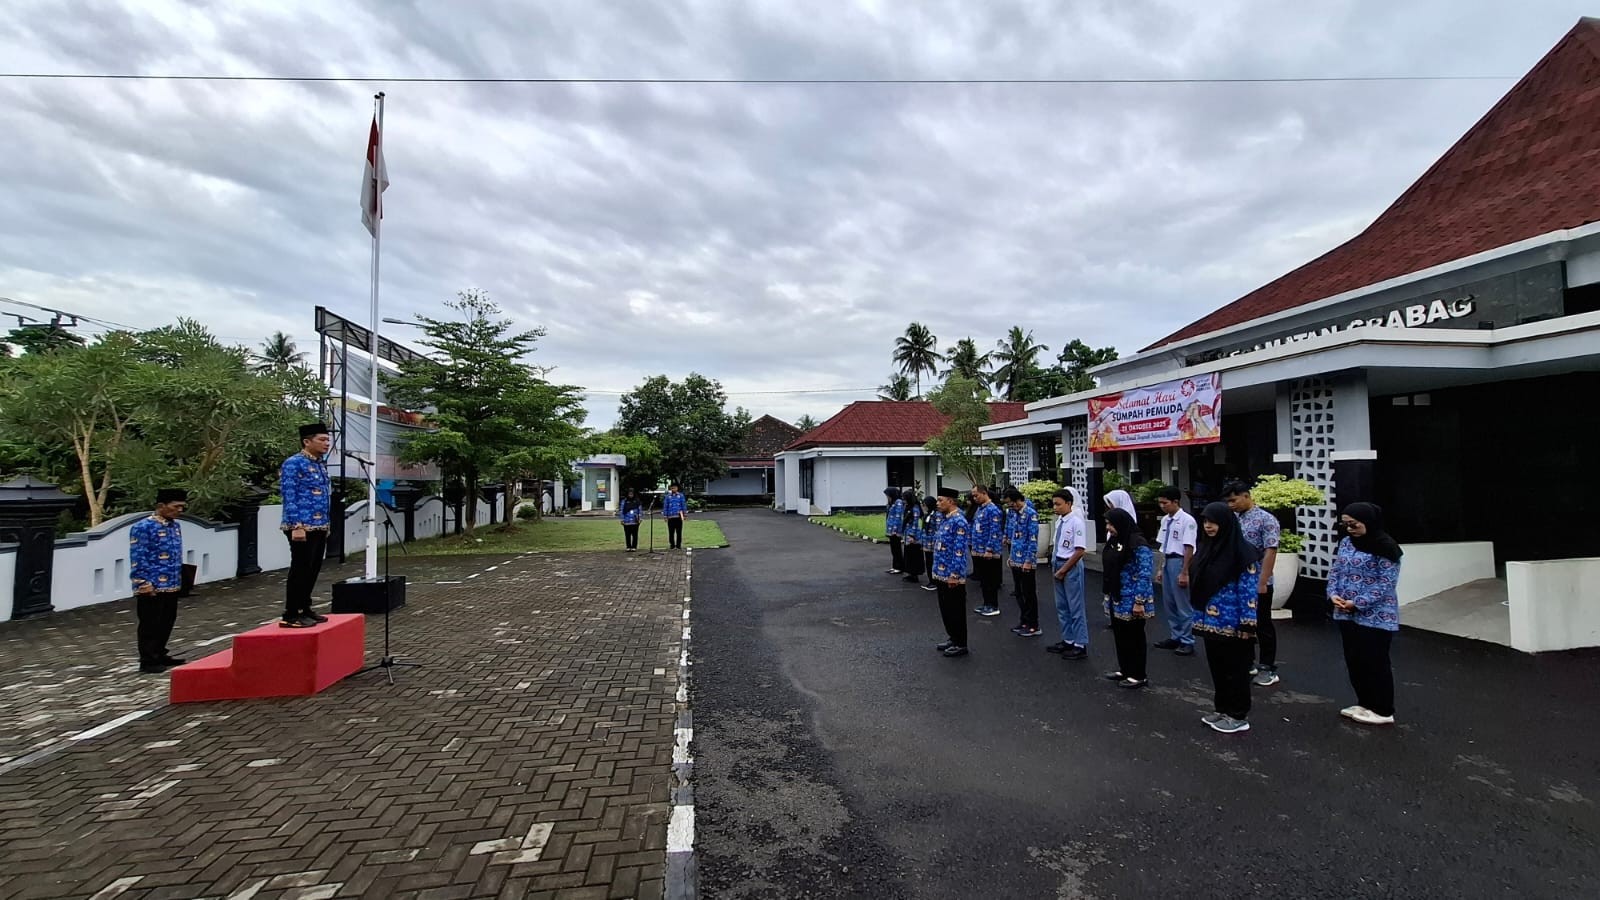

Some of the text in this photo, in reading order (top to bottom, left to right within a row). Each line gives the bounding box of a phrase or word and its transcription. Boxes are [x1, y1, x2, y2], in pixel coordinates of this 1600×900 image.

[1117, 390, 1176, 410] Selamat Hari
[1111, 402, 1183, 422] SUMPAH PEMUDA
